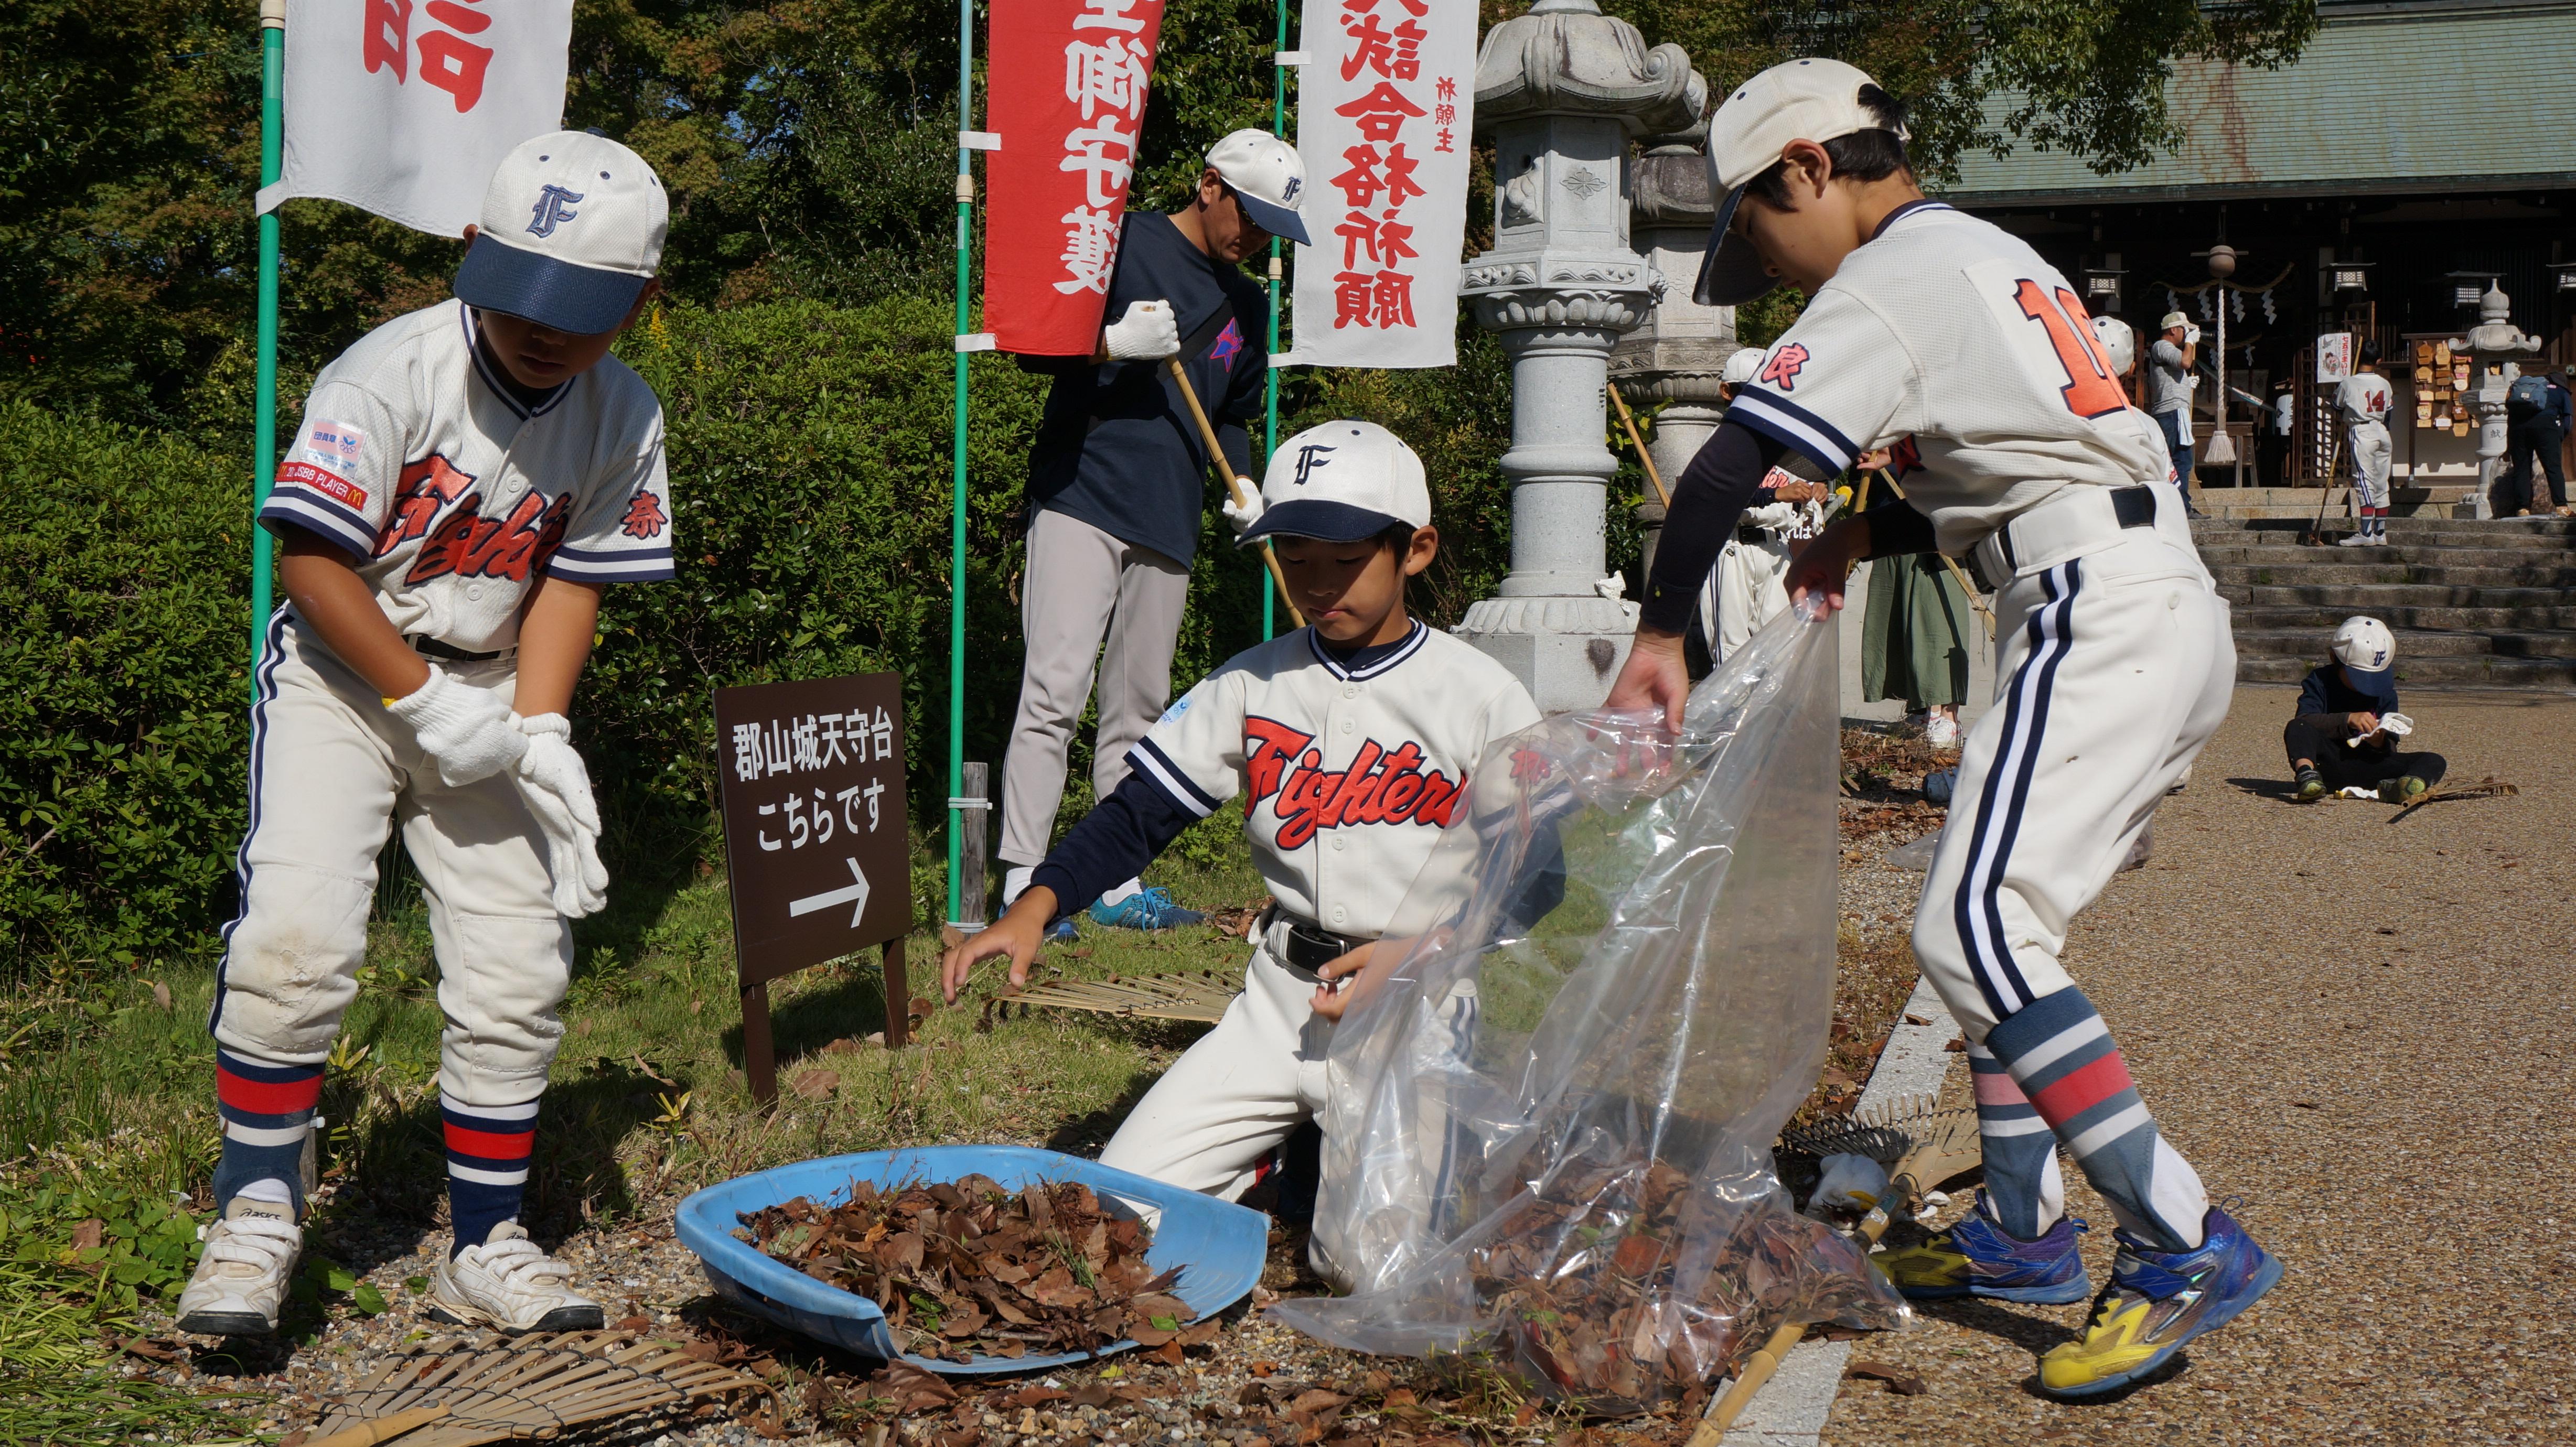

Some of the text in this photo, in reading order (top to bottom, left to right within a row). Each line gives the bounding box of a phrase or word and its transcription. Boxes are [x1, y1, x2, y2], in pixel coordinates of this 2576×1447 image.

[2365, 390, 2386, 413] 14
[315, 473, 348, 498] PLAYER
[733, 705, 894, 782] 郡山城天守台
[759, 778, 885, 851] こちらです
